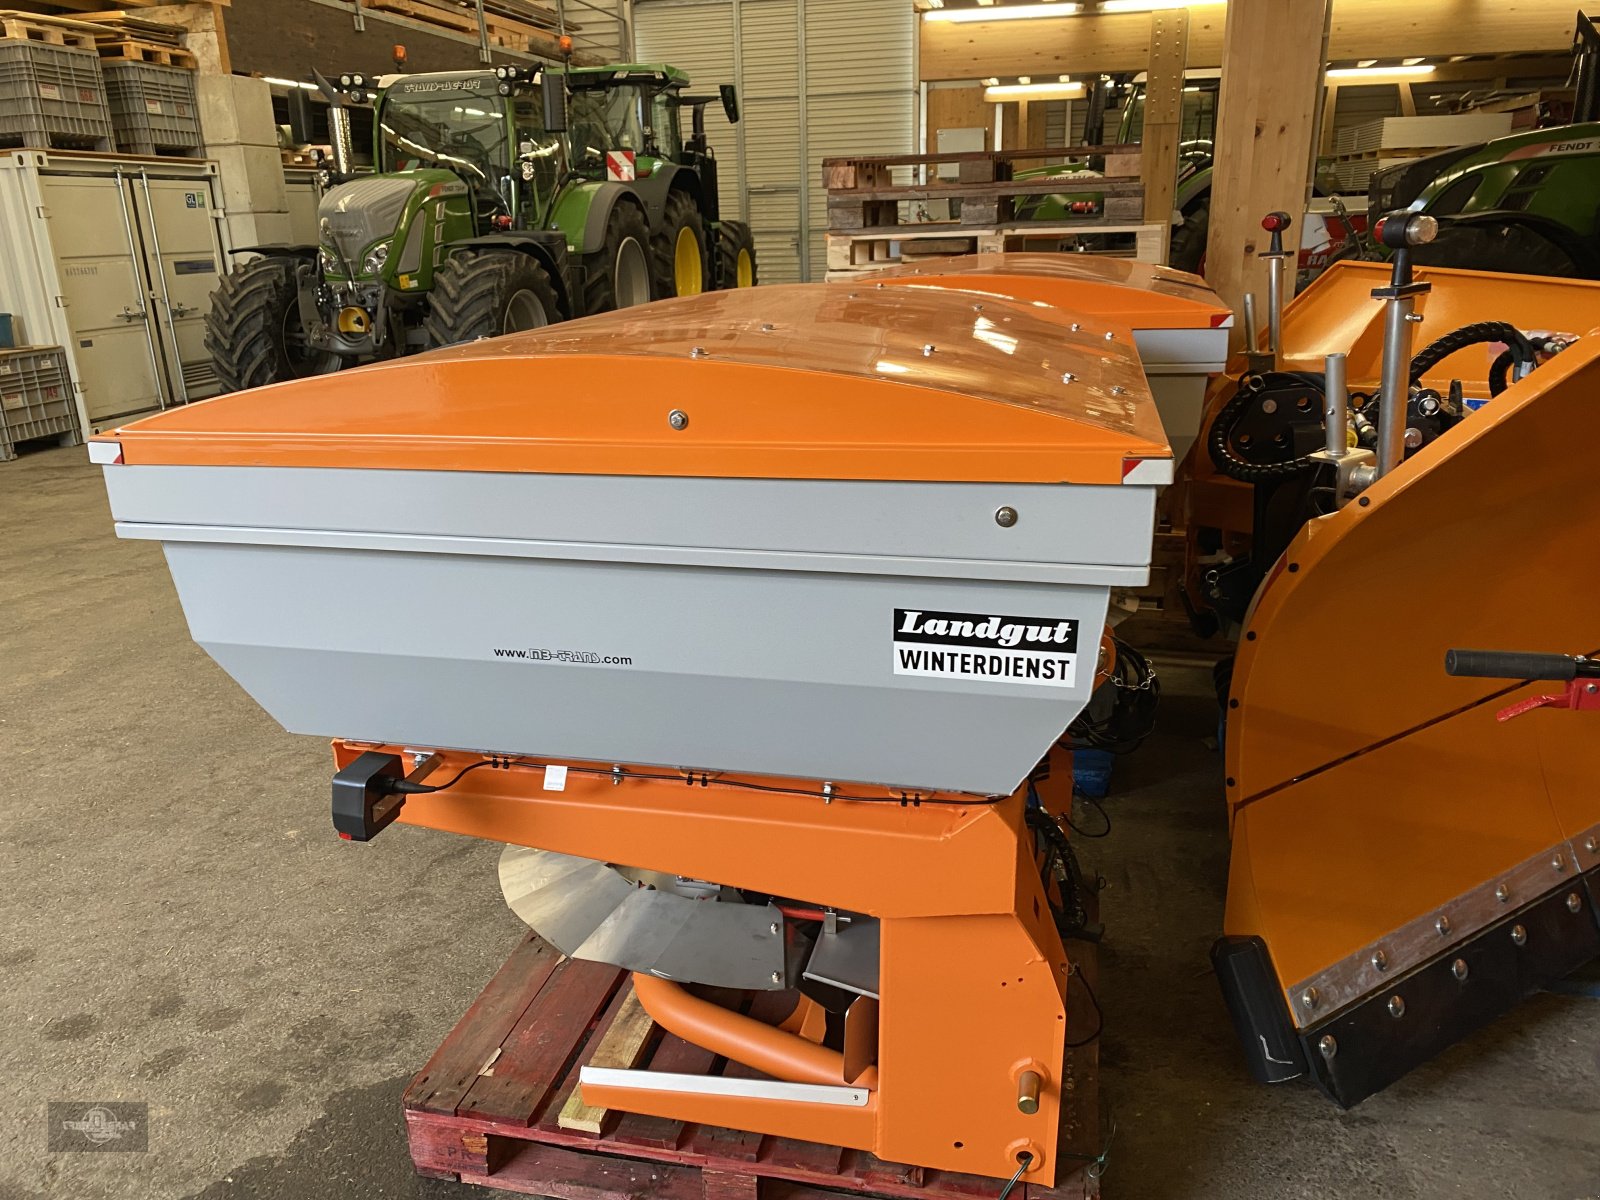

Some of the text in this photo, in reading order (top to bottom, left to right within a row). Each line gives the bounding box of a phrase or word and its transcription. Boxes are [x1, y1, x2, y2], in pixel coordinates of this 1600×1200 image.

[1548, 141, 1593, 153] FENDT
[897, 610, 1072, 648] Landgut
[899, 649, 1070, 681] WINTERDIENST
